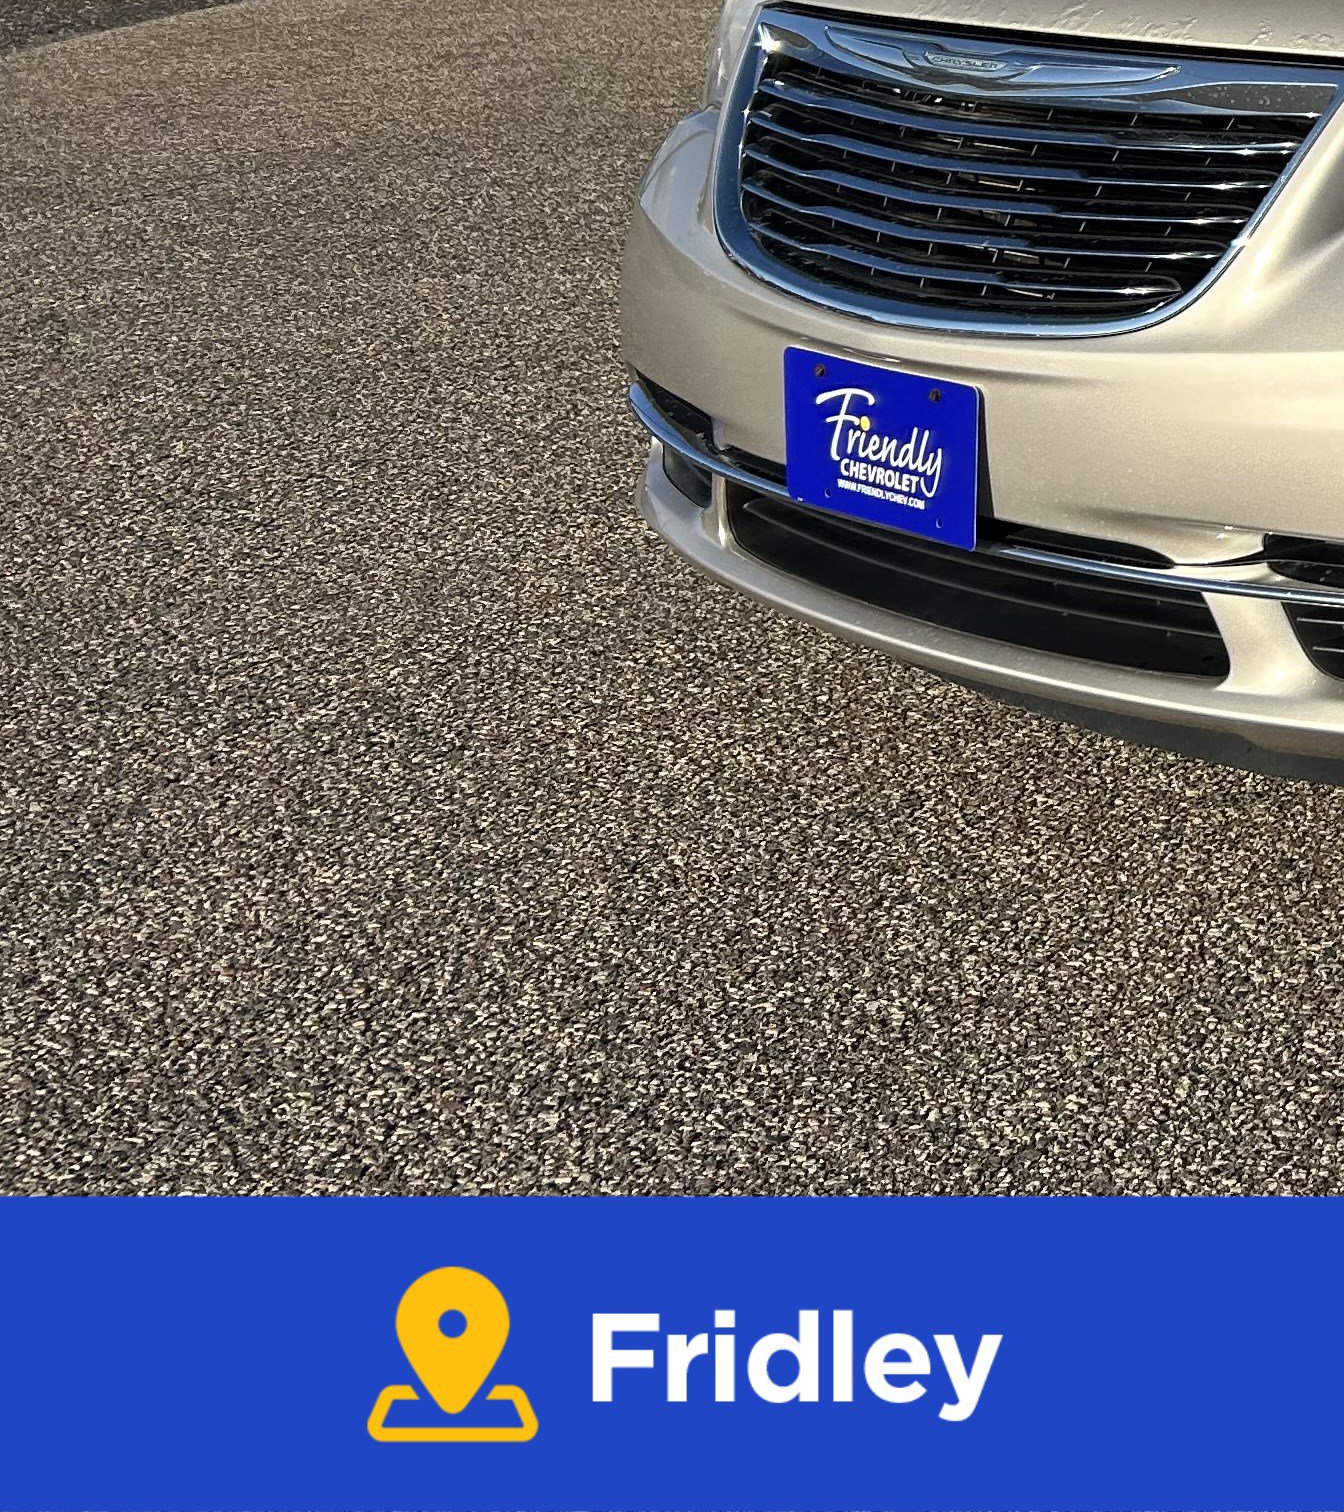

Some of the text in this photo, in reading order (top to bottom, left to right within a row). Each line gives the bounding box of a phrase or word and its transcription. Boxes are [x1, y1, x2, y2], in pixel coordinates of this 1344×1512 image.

[931, 55, 998, 69] CHRYSLER
[816, 388, 943, 498] Friendly
[840, 458, 921, 494] CHEVROLET
[837, 478, 925, 510] WWW.FRIENDLYCHEV.COM
